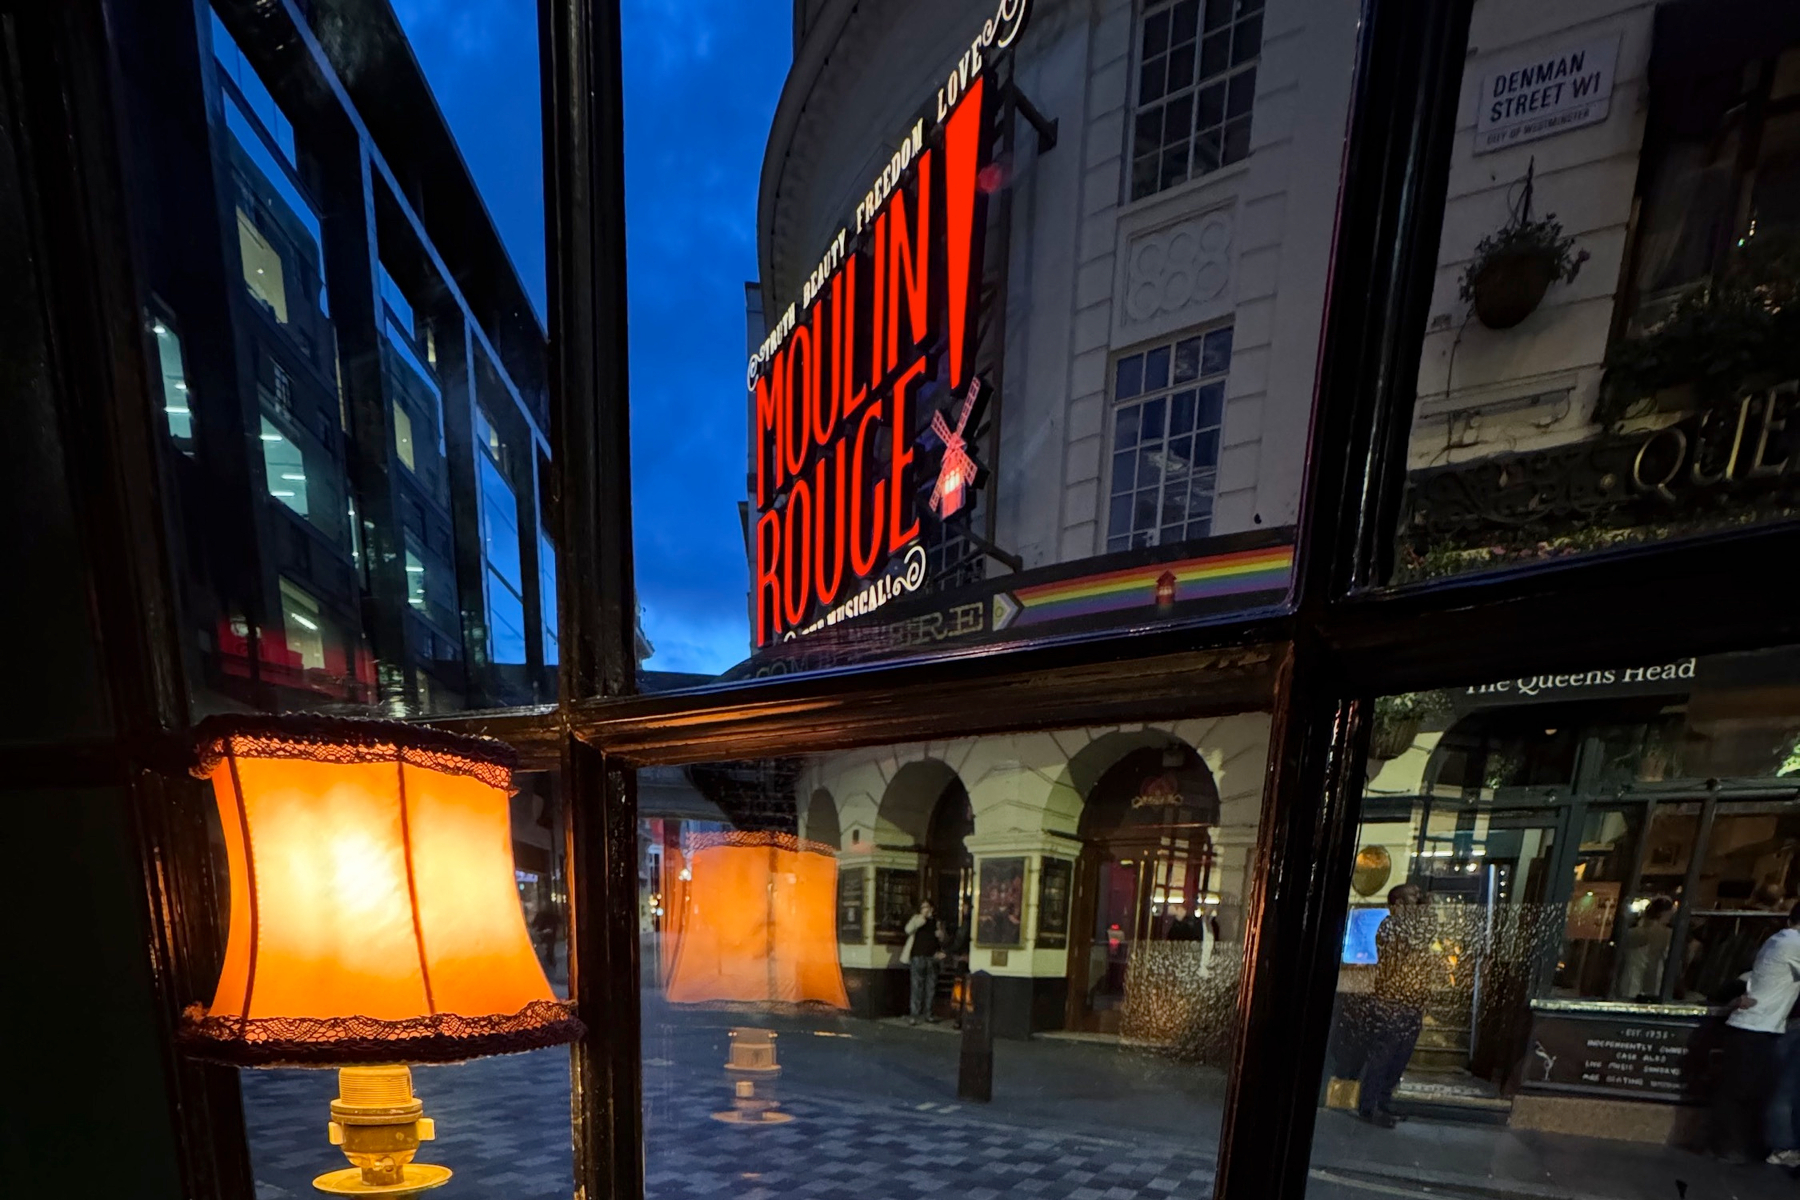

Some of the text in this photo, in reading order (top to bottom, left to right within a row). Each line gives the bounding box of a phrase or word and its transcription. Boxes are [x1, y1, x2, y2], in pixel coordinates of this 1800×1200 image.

[1490, 71, 1600, 123] STREET W1
[1493, 51, 1585, 98] DENMAN
[760, 34, 982, 362] TRUTH BEAUTY FREEDOM LOVE
[757, 355, 927, 648] ROUGE
[1517, 668, 1616, 696] Queens
[1621, 657, 1697, 684] Head
[1587, 1039, 1653, 1052] INDEPENDENTLY
